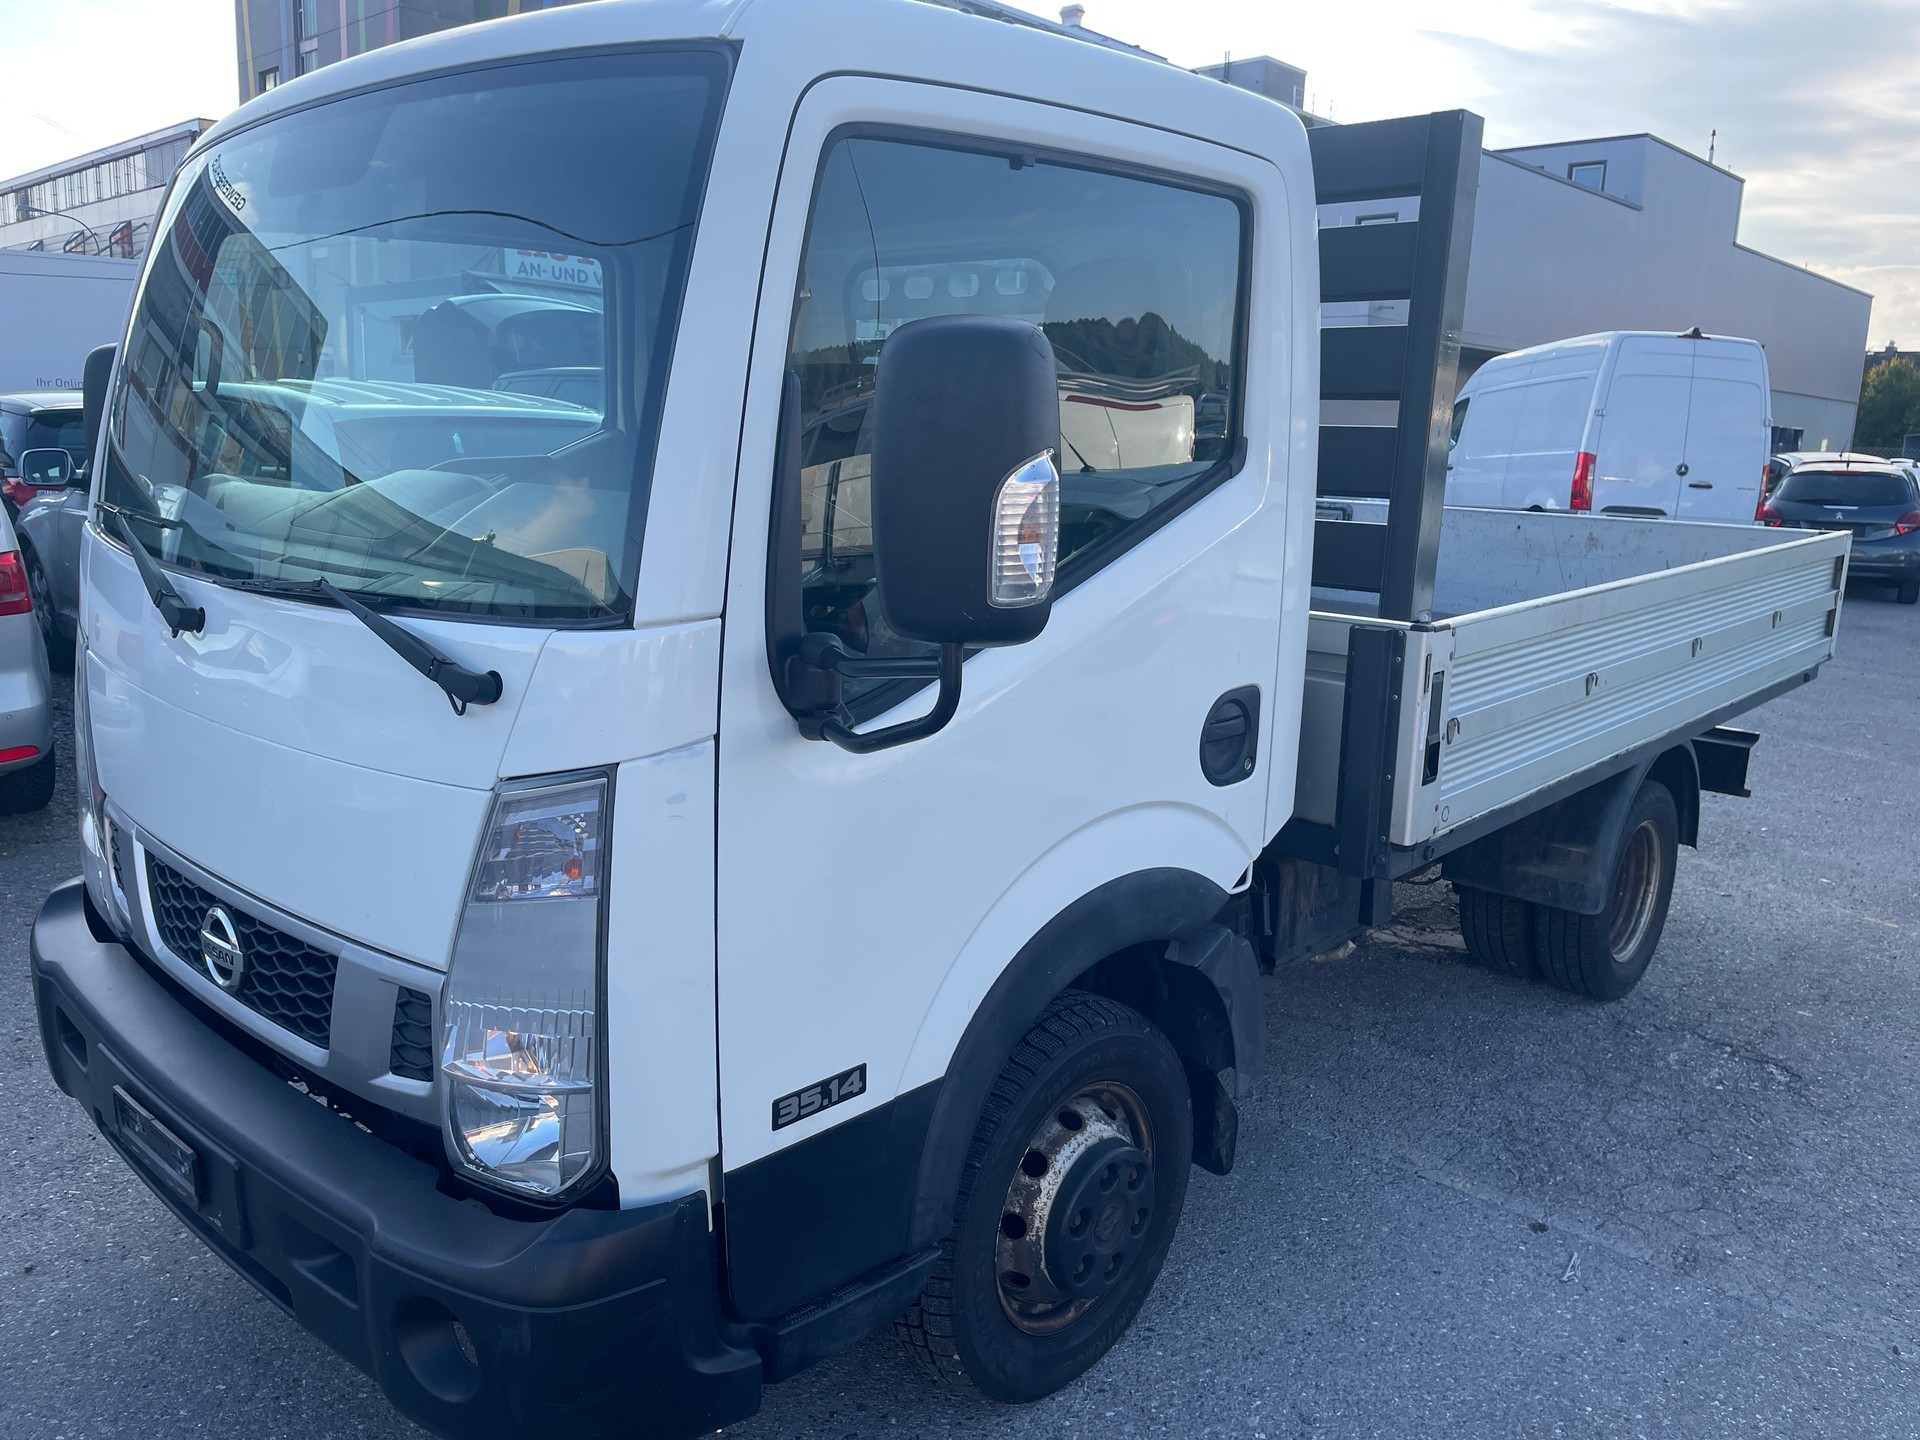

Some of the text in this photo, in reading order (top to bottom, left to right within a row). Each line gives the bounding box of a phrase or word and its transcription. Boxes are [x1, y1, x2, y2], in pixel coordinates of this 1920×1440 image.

[517, 261, 547, 278] AN-
[551, 265, 589, 284] UND
[36, 377, 52, 388] Ihr
[777, 1069, 863, 1126] 35.14
